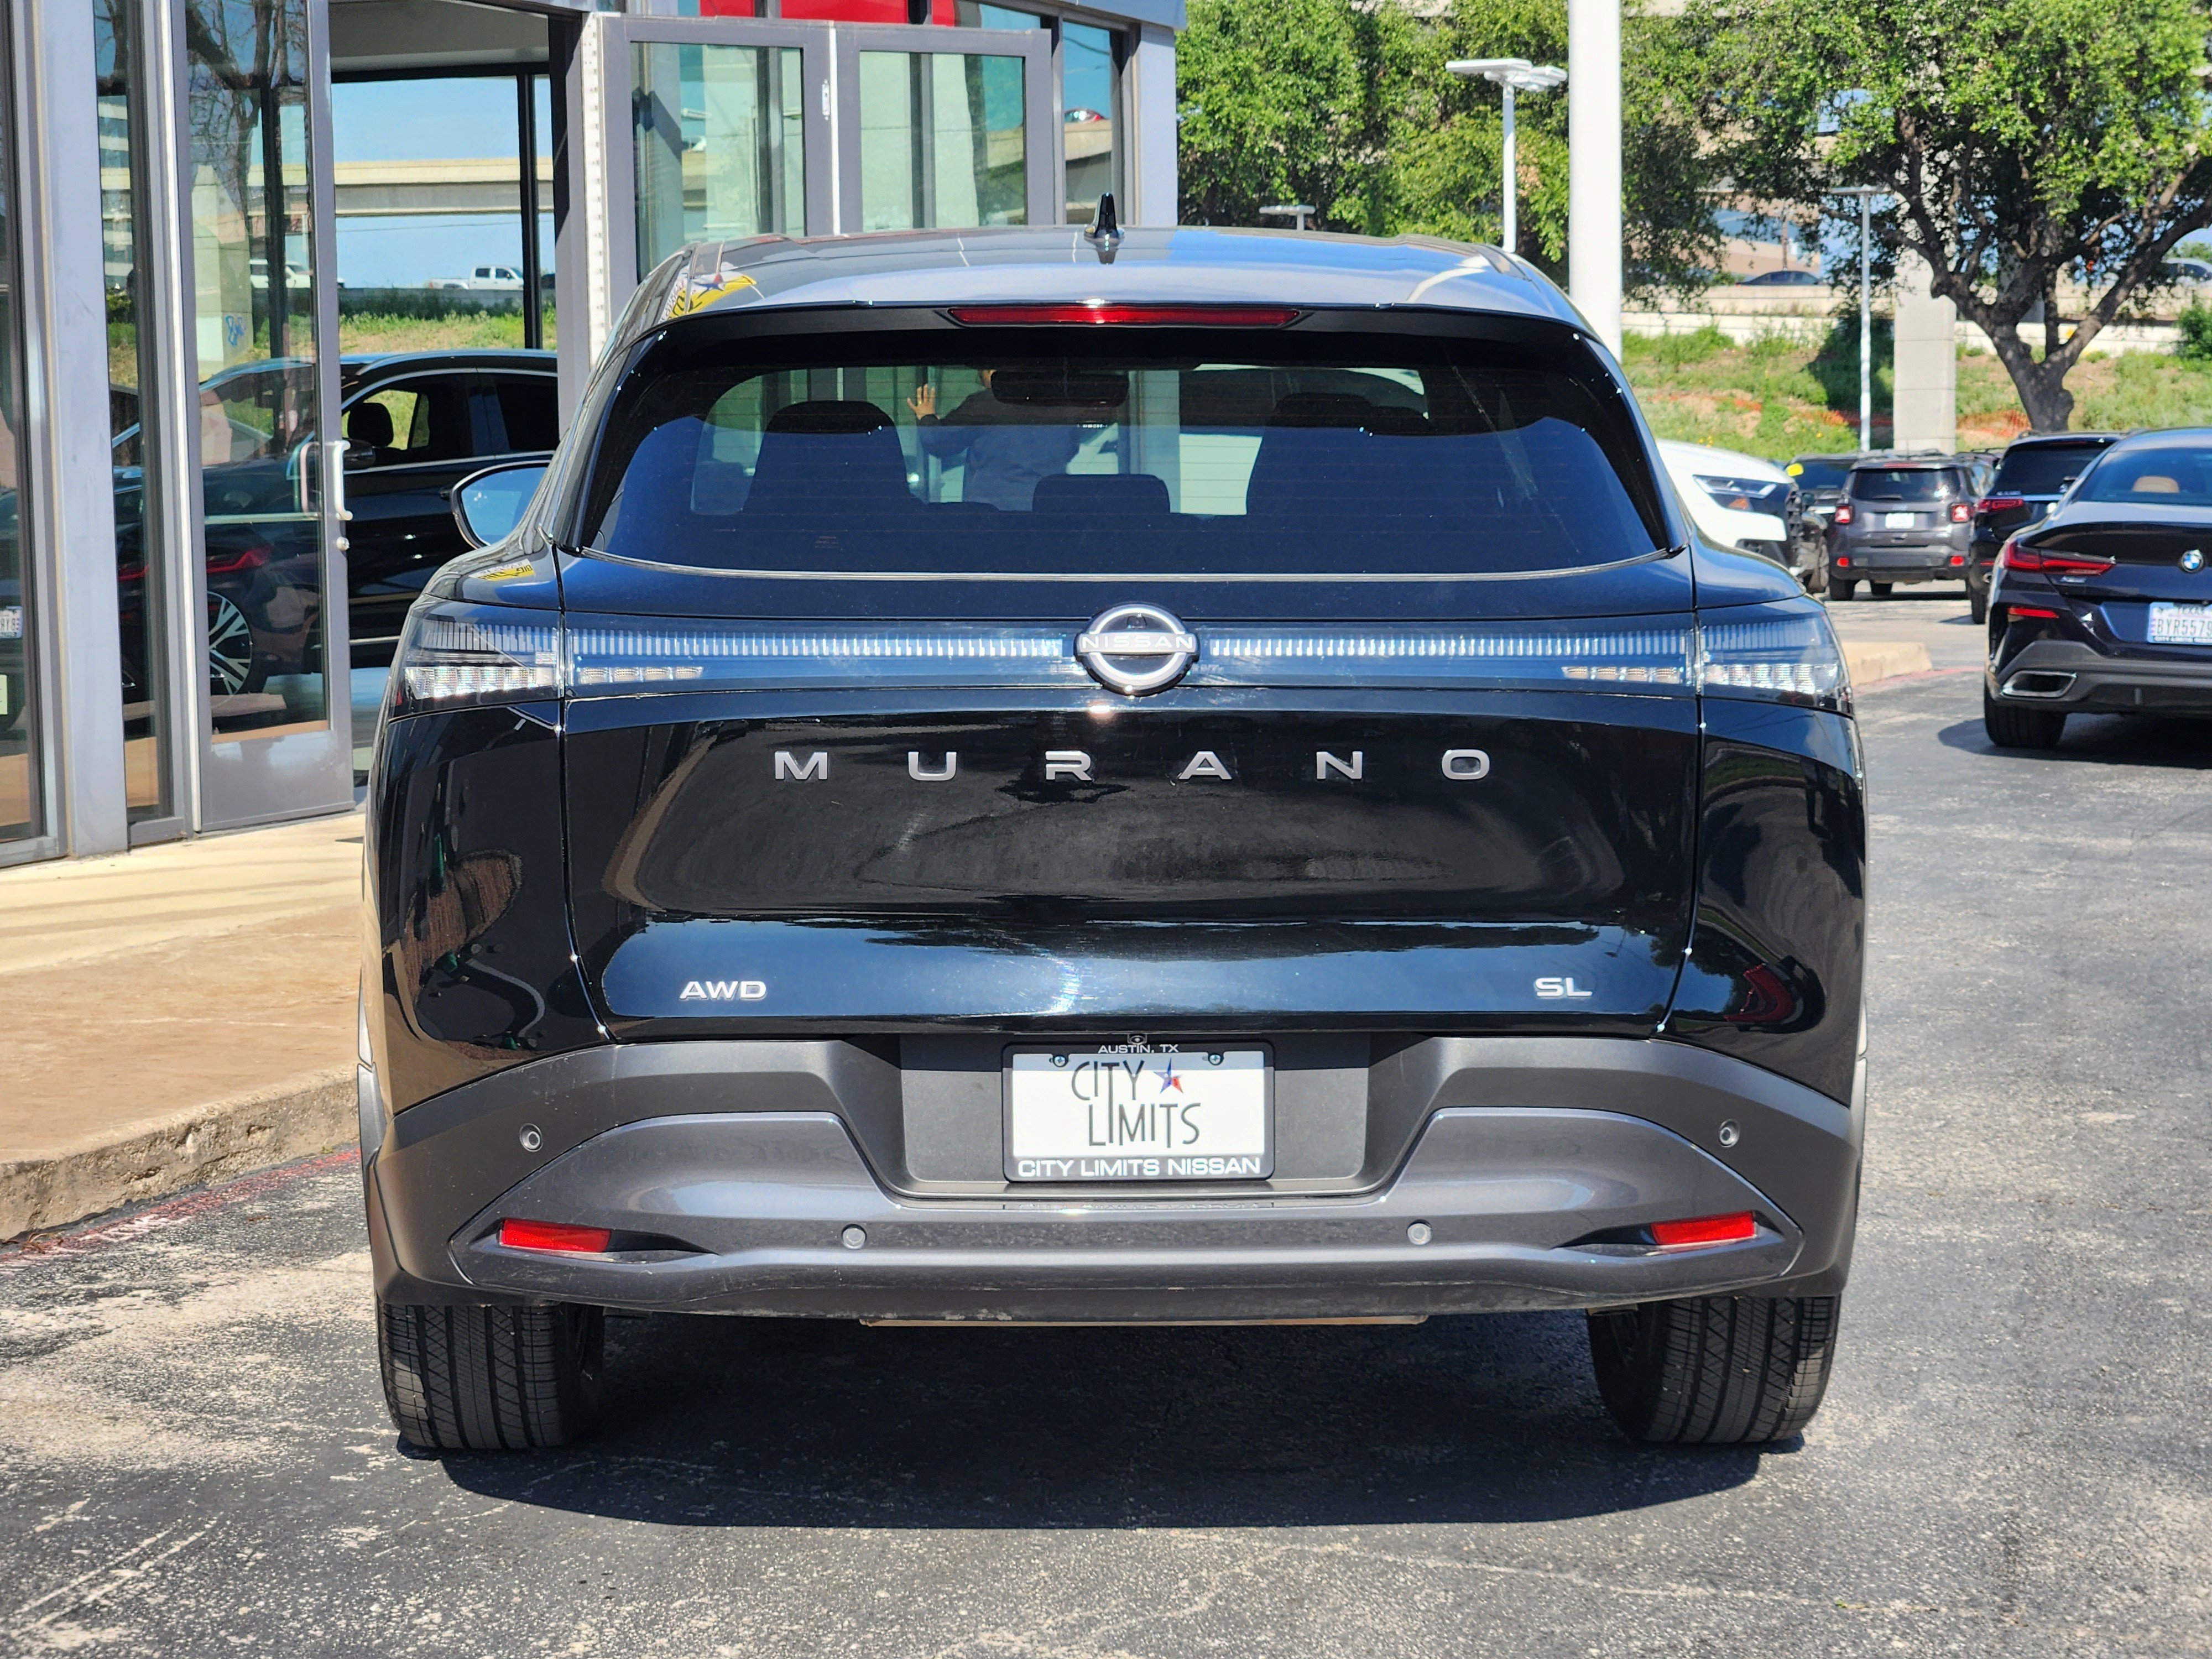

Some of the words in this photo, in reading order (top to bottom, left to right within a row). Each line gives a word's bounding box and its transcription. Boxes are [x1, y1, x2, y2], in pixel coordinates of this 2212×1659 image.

[1082, 636, 1193, 649] NISSAN
[774, 749, 1490, 781] MURANO
[679, 981, 766, 999] AWD
[1535, 977, 1593, 997] SL
[1159, 1044, 1179, 1053] TX
[1088, 1103, 1201, 1148] LIMITS
[1018, 1160, 1074, 1177] CITY
[1081, 1159, 1160, 1177] LIMITS
[1167, 1157, 1261, 1176] NISSAN
